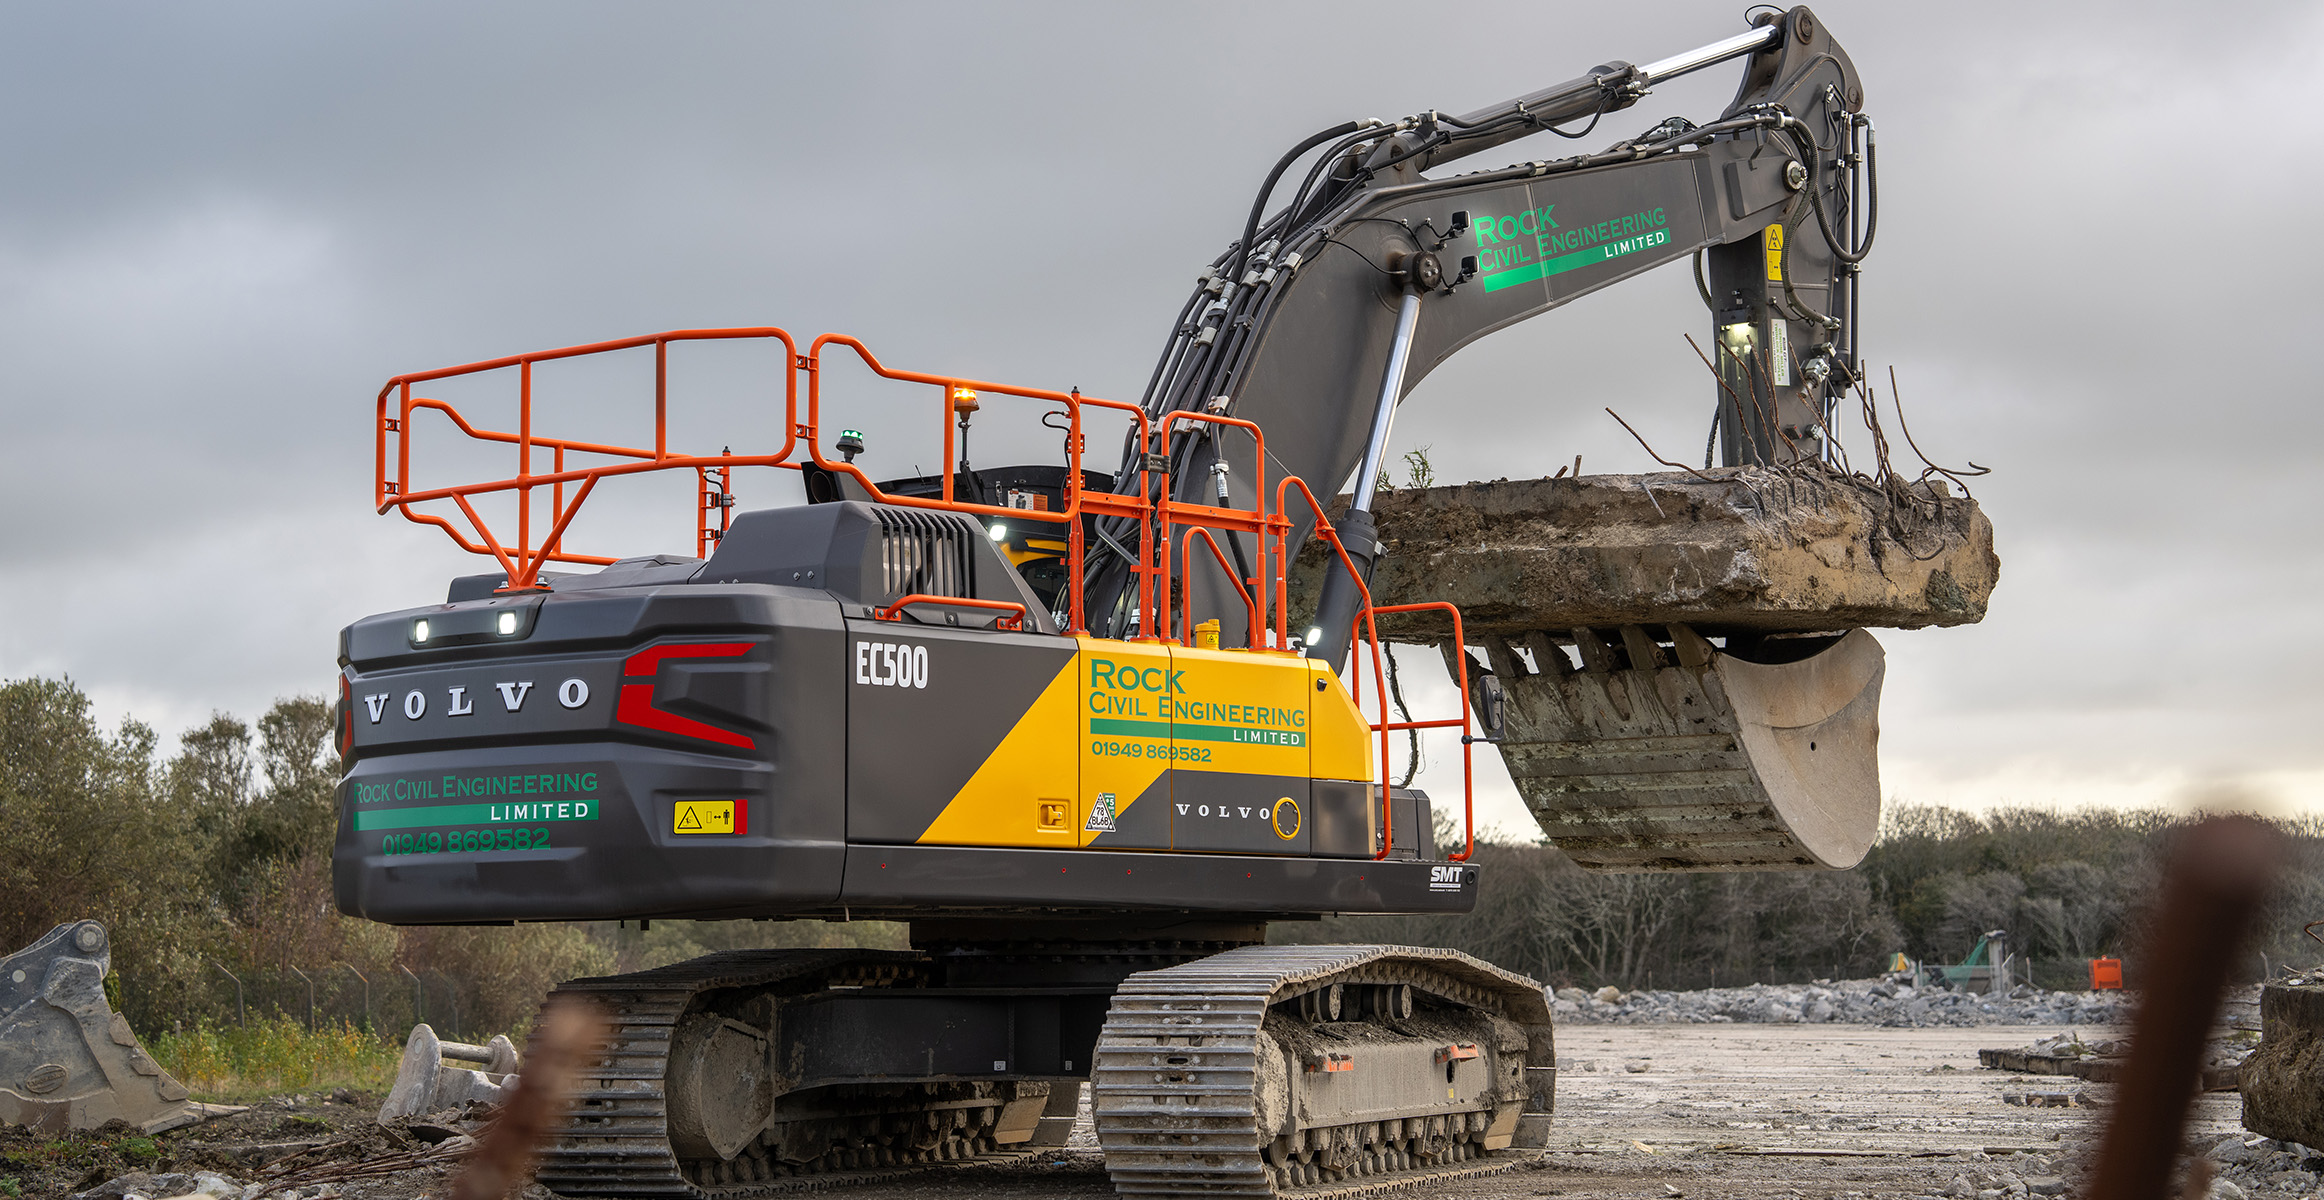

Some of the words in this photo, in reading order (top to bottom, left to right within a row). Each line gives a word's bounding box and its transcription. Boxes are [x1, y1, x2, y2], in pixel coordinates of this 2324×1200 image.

[1473, 204, 1560, 248] ROCK
[1479, 245, 1531, 271] CIVIL
[1537, 207, 1666, 257] ENGINEERING
[1604, 231, 1665, 258] LIMITED
[856, 641, 928, 689] EC500
[1090, 658, 1186, 694] ROCK
[364, 678, 589, 724] VOLVO
[1089, 691, 1147, 716] CIVIL
[1158, 695, 1305, 728] ENGINEERING
[1233, 729, 1300, 745] LIMITED
[1091, 741, 1143, 758] 01949
[1146, 744, 1212, 763] 869582
[353, 782, 391, 804] ROCK
[394, 778, 439, 800] CIVIL
[443, 772, 598, 797] ENGINEERING
[490, 802, 588, 821] LIMITED
[1096, 806, 1105, 816] 78
[1175, 803, 1270, 820] VOLVO
[382, 832, 442, 856] 01949
[447, 827, 551, 853] 869582
[1430, 866, 1463, 882] SMT
